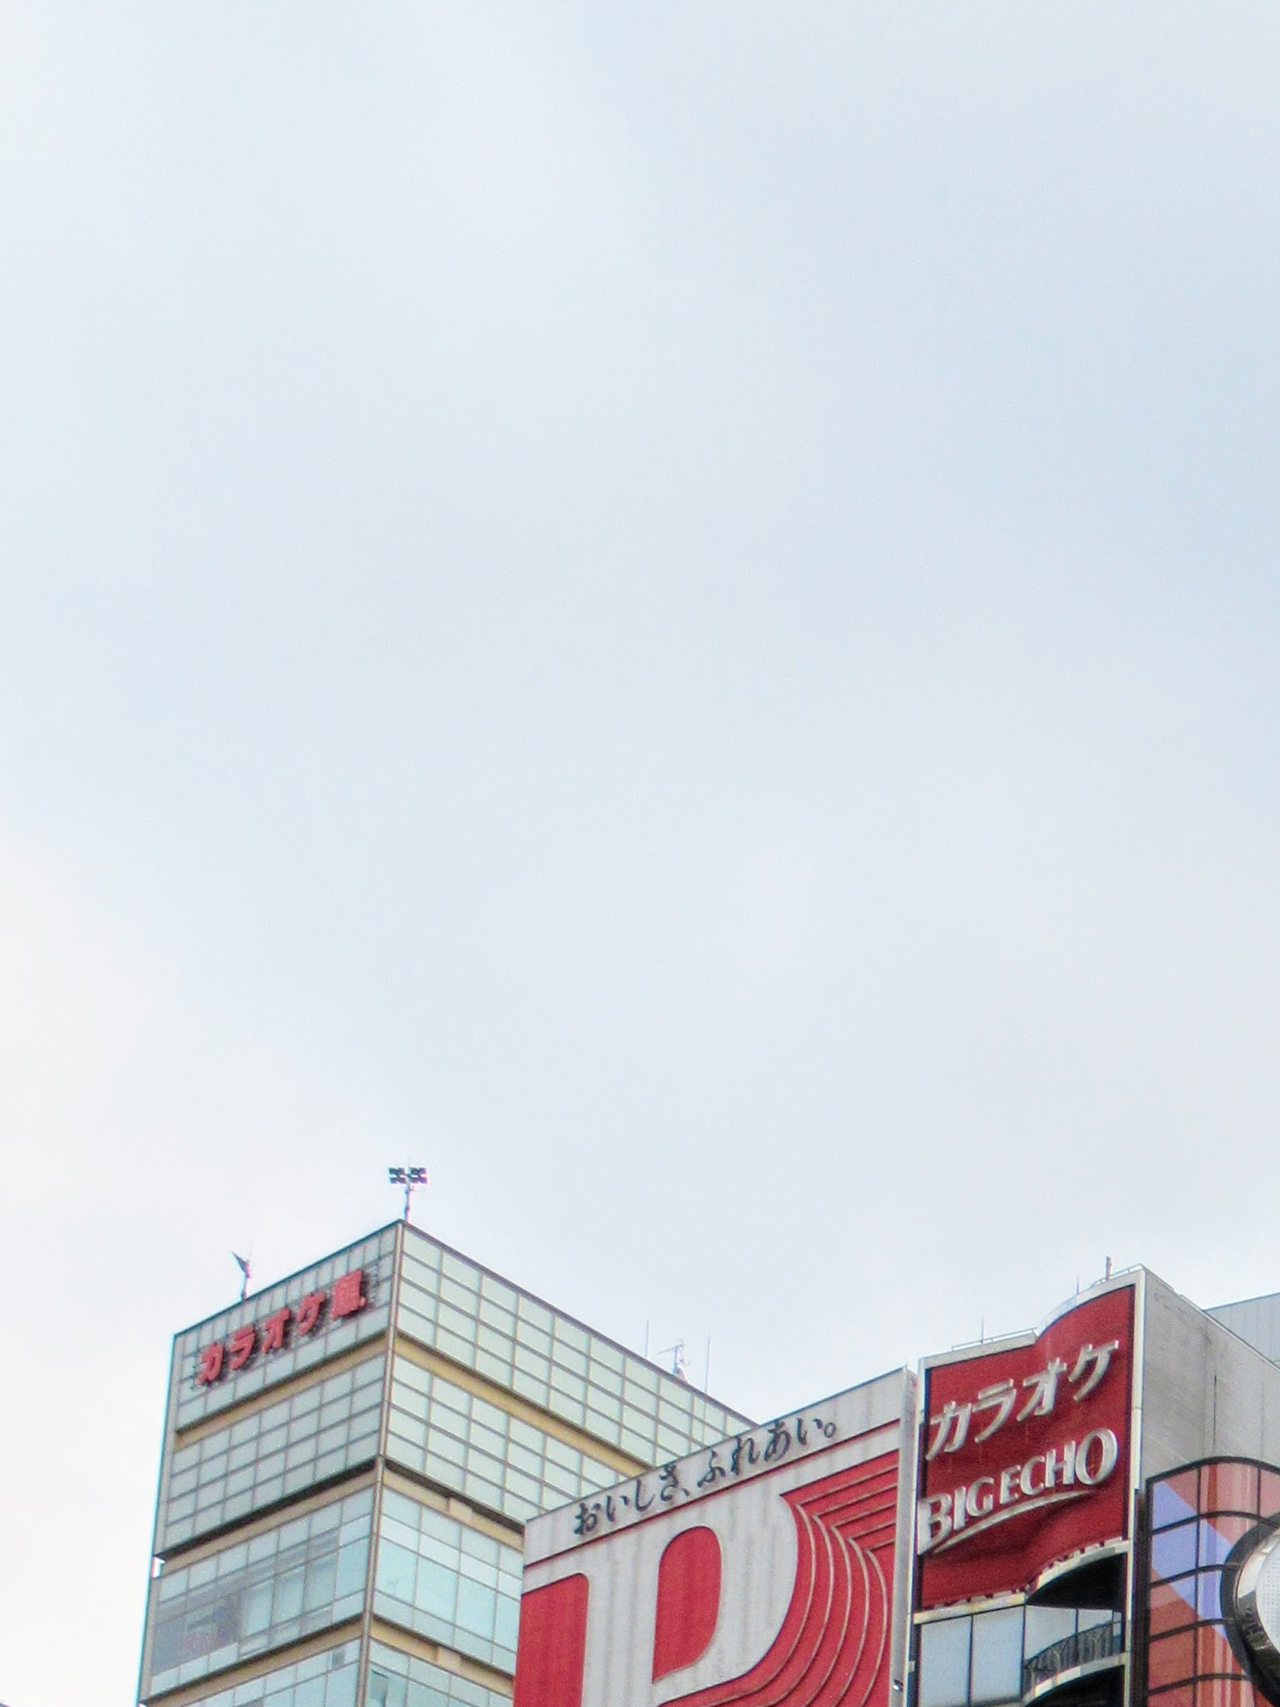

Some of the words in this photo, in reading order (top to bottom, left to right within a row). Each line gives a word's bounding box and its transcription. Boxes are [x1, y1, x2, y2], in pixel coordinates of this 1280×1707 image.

[925, 1340, 1119, 1461] カラオケ
[573, 1417, 837, 1537] おいしさ、ふれあい。
